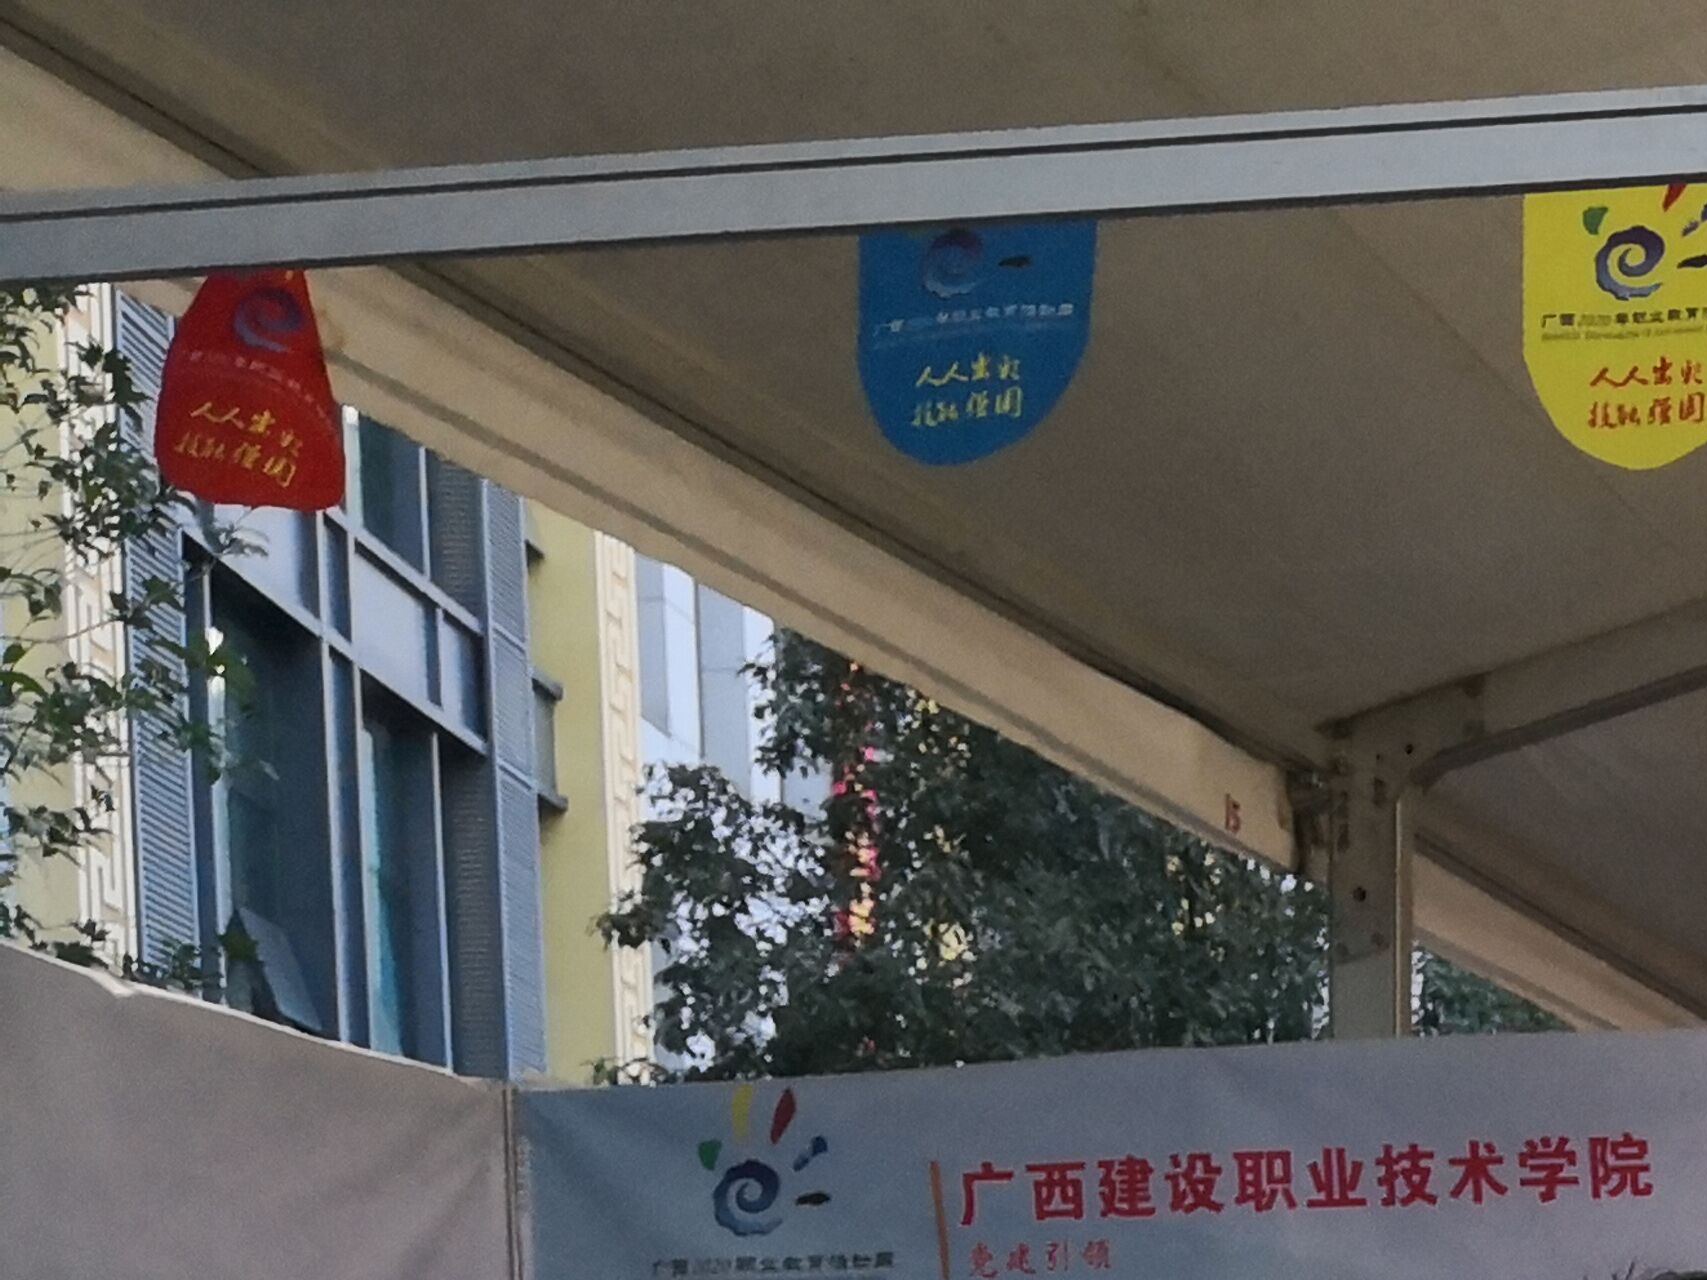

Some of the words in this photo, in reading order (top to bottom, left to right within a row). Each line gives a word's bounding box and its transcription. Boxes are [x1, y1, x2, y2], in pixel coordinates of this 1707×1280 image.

[961, 1132, 1654, 1226] 广西建设职业技术学院
[969, 1239, 1113, 1278] 党建引领
